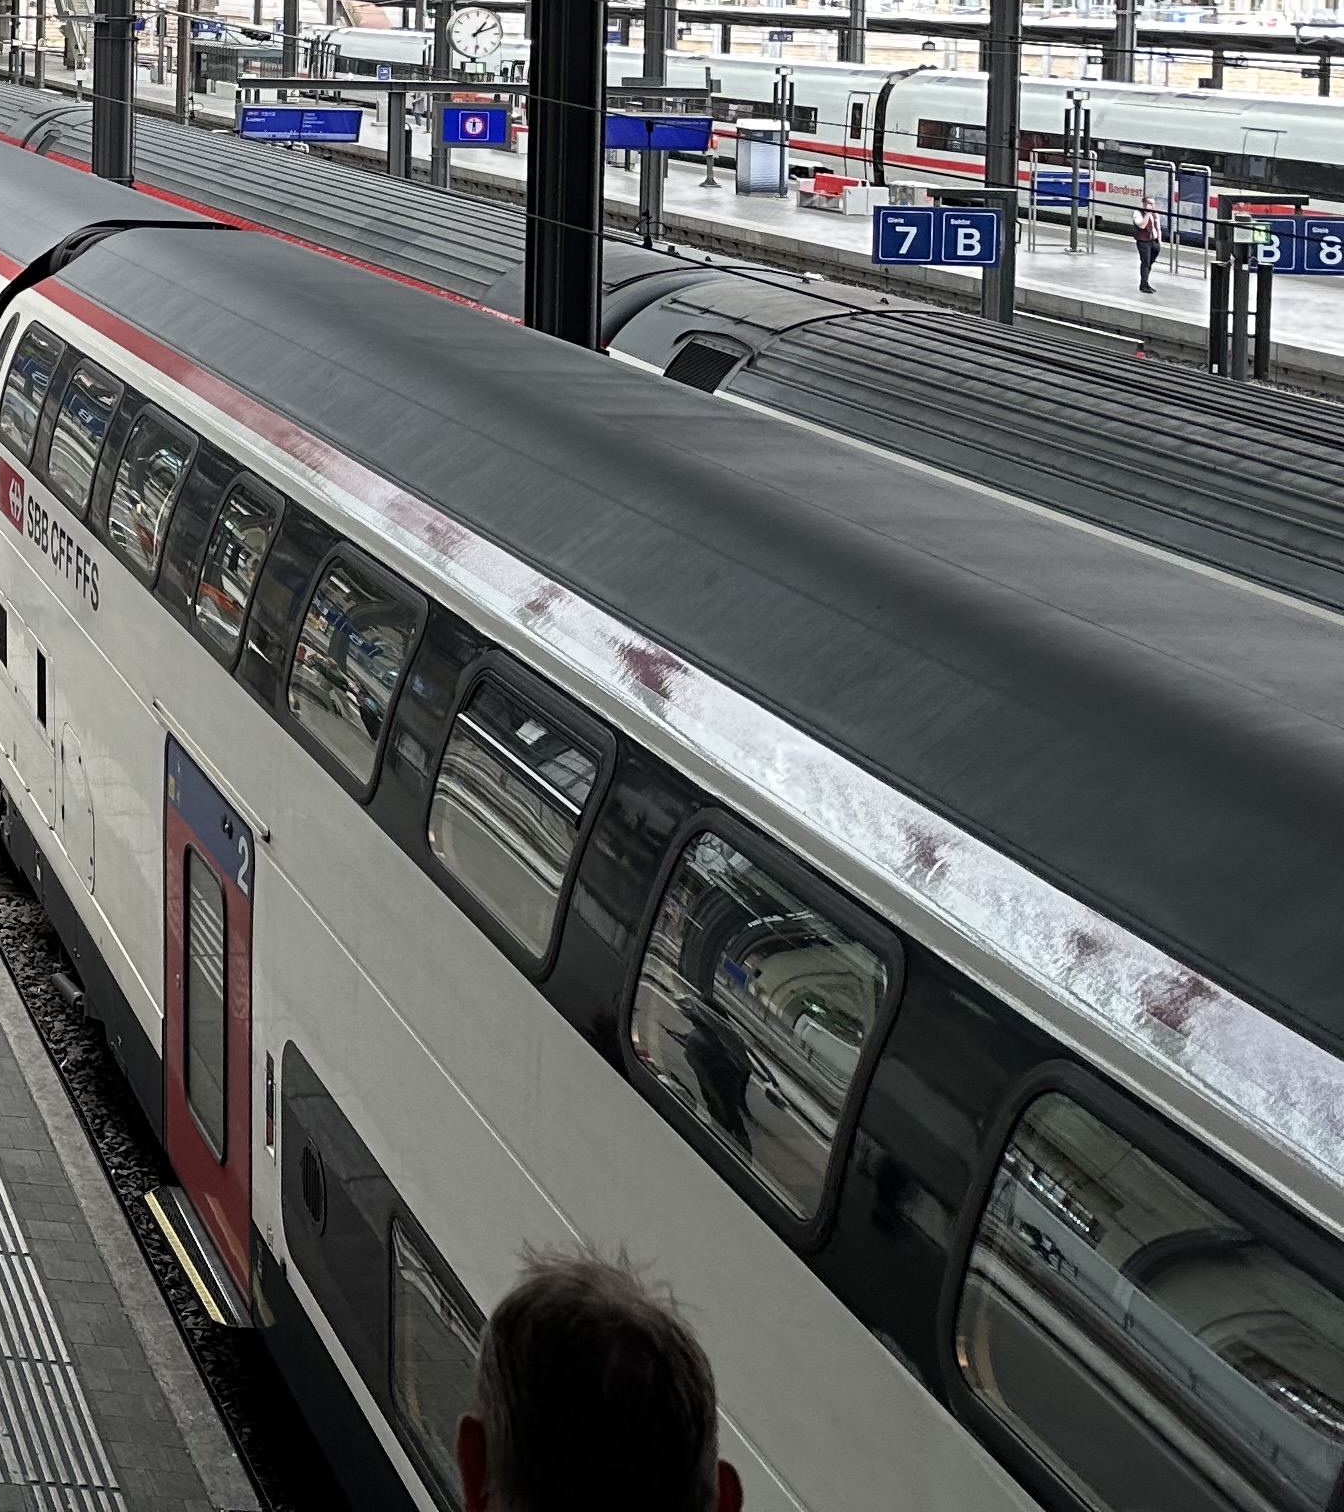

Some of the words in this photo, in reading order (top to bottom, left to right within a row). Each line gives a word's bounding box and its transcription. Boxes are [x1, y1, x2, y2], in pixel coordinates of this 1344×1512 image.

[895, 225, 918, 255] 7
[956, 227, 982, 257] B
[1257, 234, 1281, 264] B
[1319, 235, 1343, 265] 8
[27, 495, 49, 555] SBB
[51, 520, 74, 580] CFF
[75, 544, 100, 612] FFS
[237, 835, 249, 896] 2
